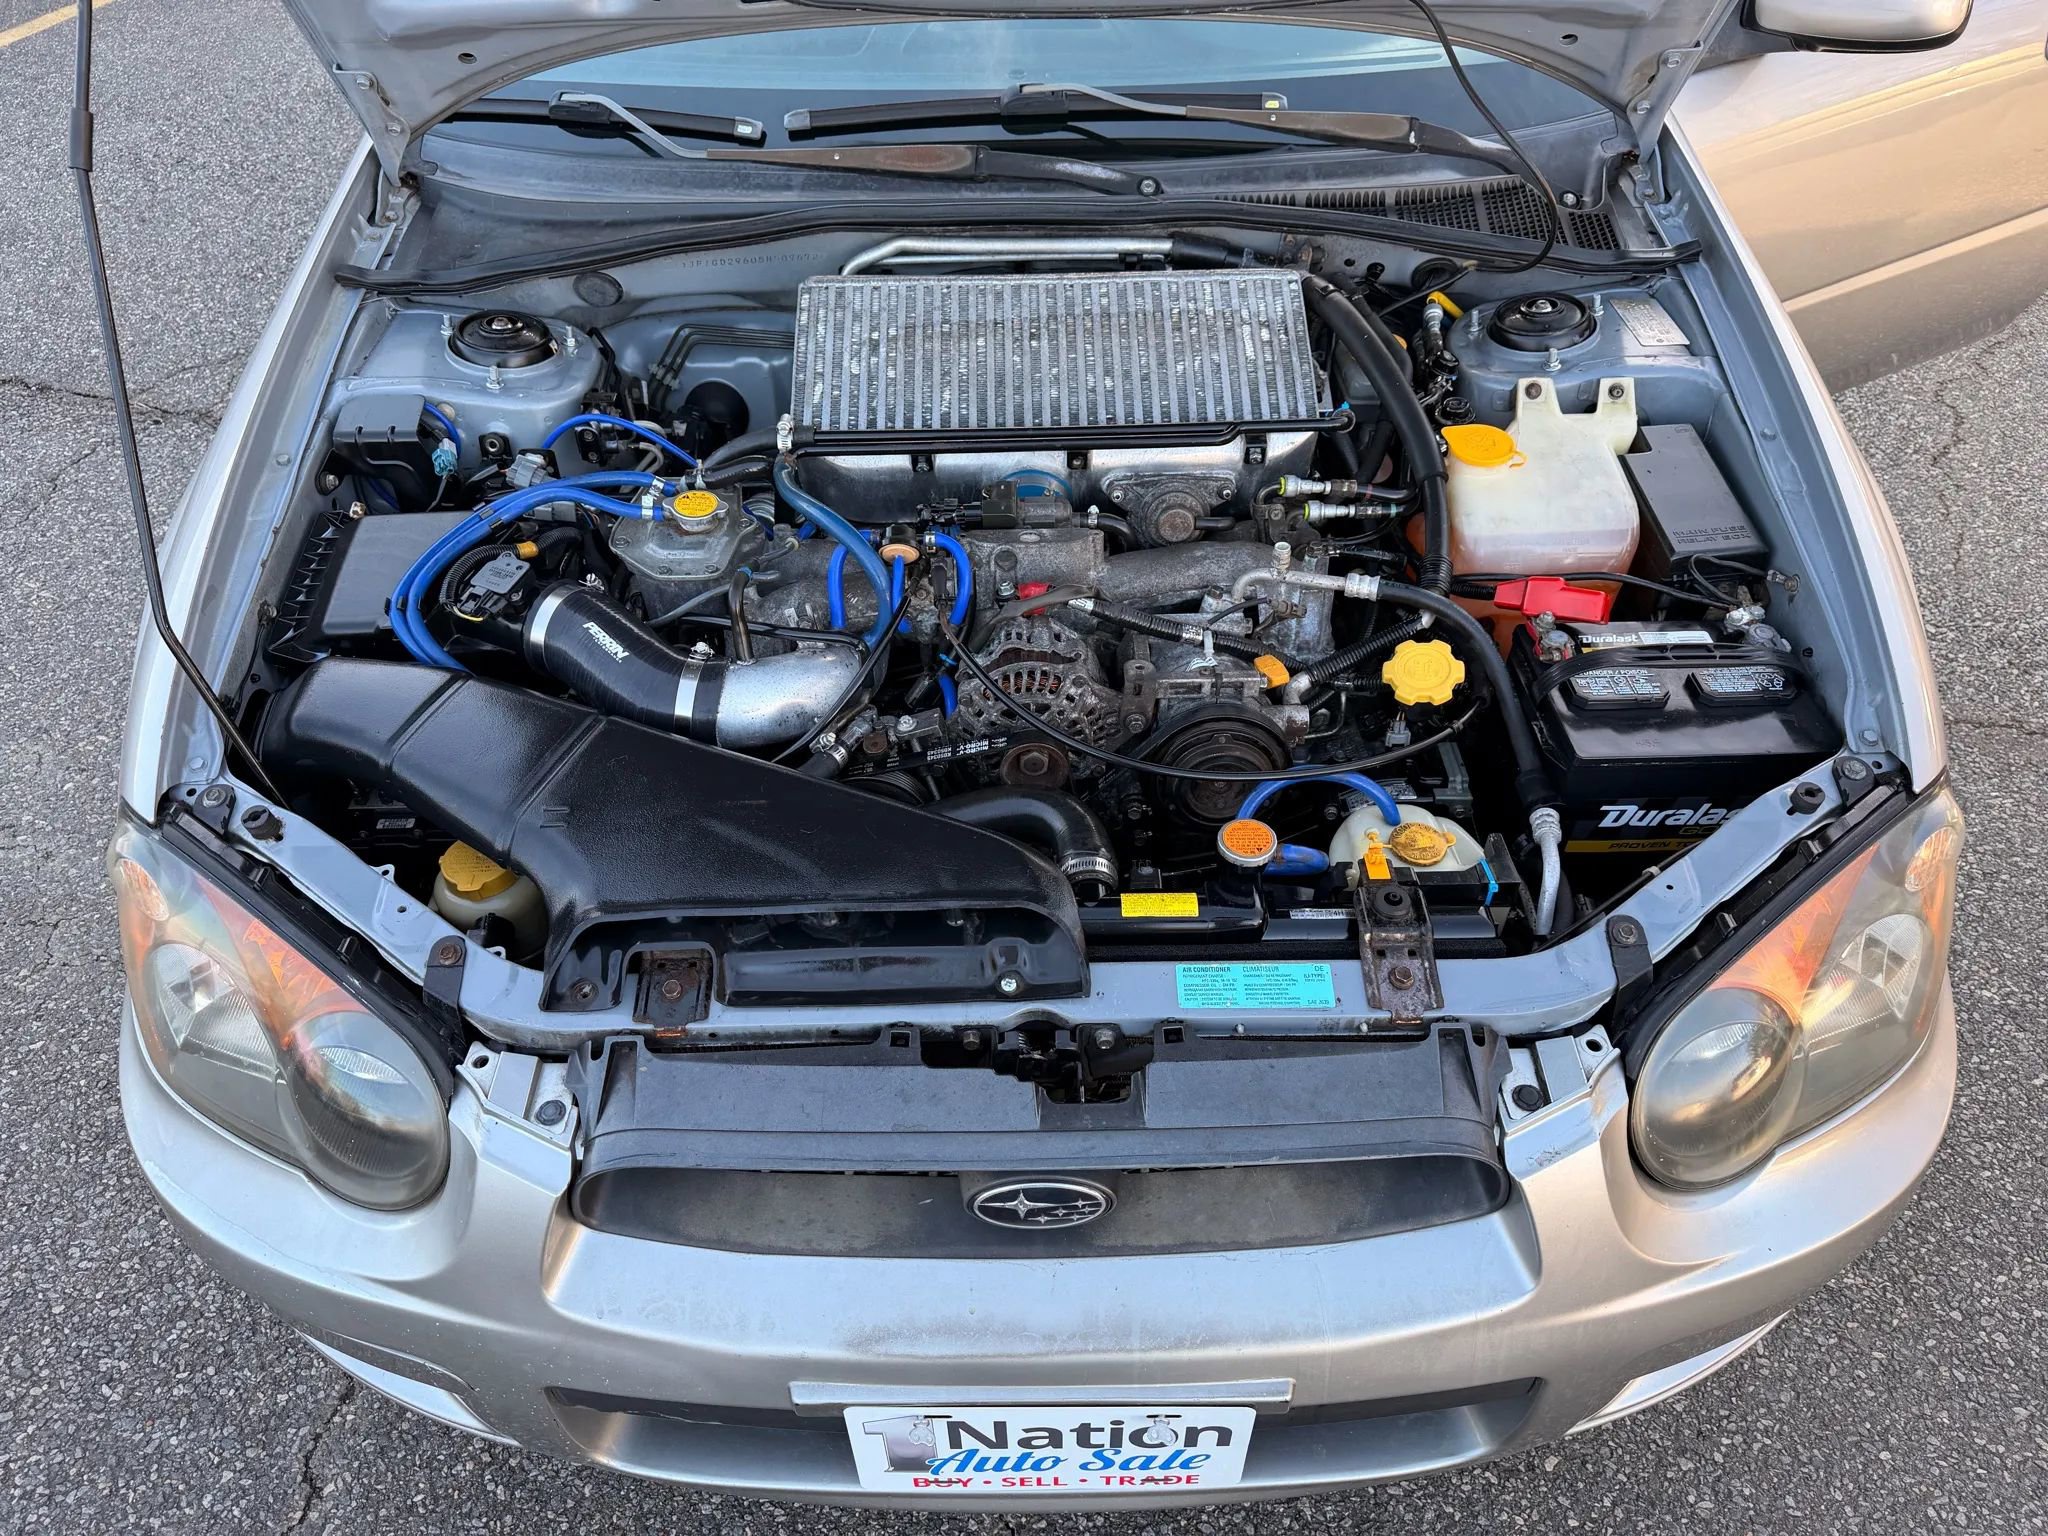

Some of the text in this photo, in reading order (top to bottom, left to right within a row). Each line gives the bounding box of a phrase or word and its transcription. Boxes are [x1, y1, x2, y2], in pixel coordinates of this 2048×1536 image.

[1710, 525, 1746, 533] FUSE
[1721, 533, 1752, 541] BOX
[582, 621, 630, 659] PERRIN
[1579, 632, 1639, 644] Duralast
[1608, 841, 1670, 850] PROVEN
[862, 1415, 1233, 1473] 1 Nation
[926, 1448, 1212, 1476] Auto Sale
[913, 1475, 1200, 1488] BUY SELL TRADE
